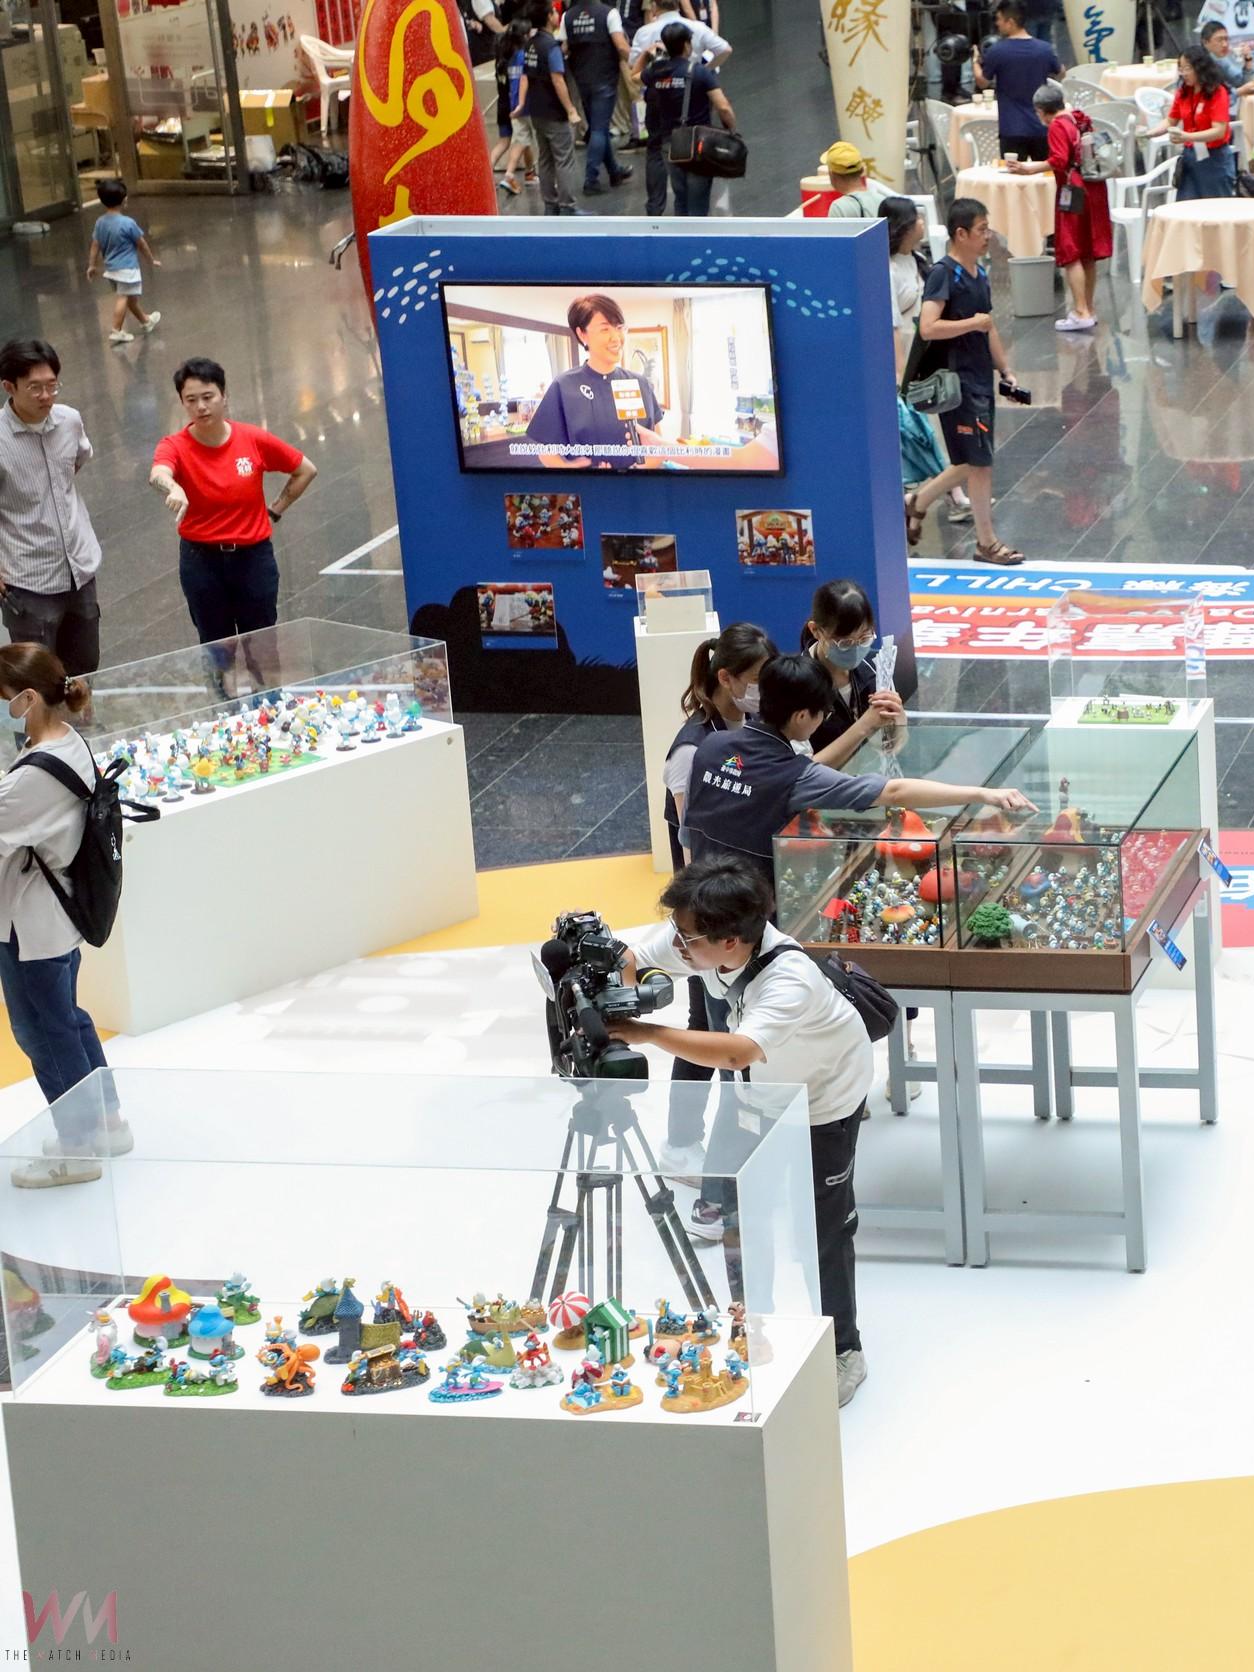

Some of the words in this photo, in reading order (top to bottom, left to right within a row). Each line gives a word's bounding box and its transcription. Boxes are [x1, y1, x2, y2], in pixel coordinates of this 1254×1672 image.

[915, 574, 1093, 591] CHILL
[702, 770, 752, 797] 觀光旅遊局
